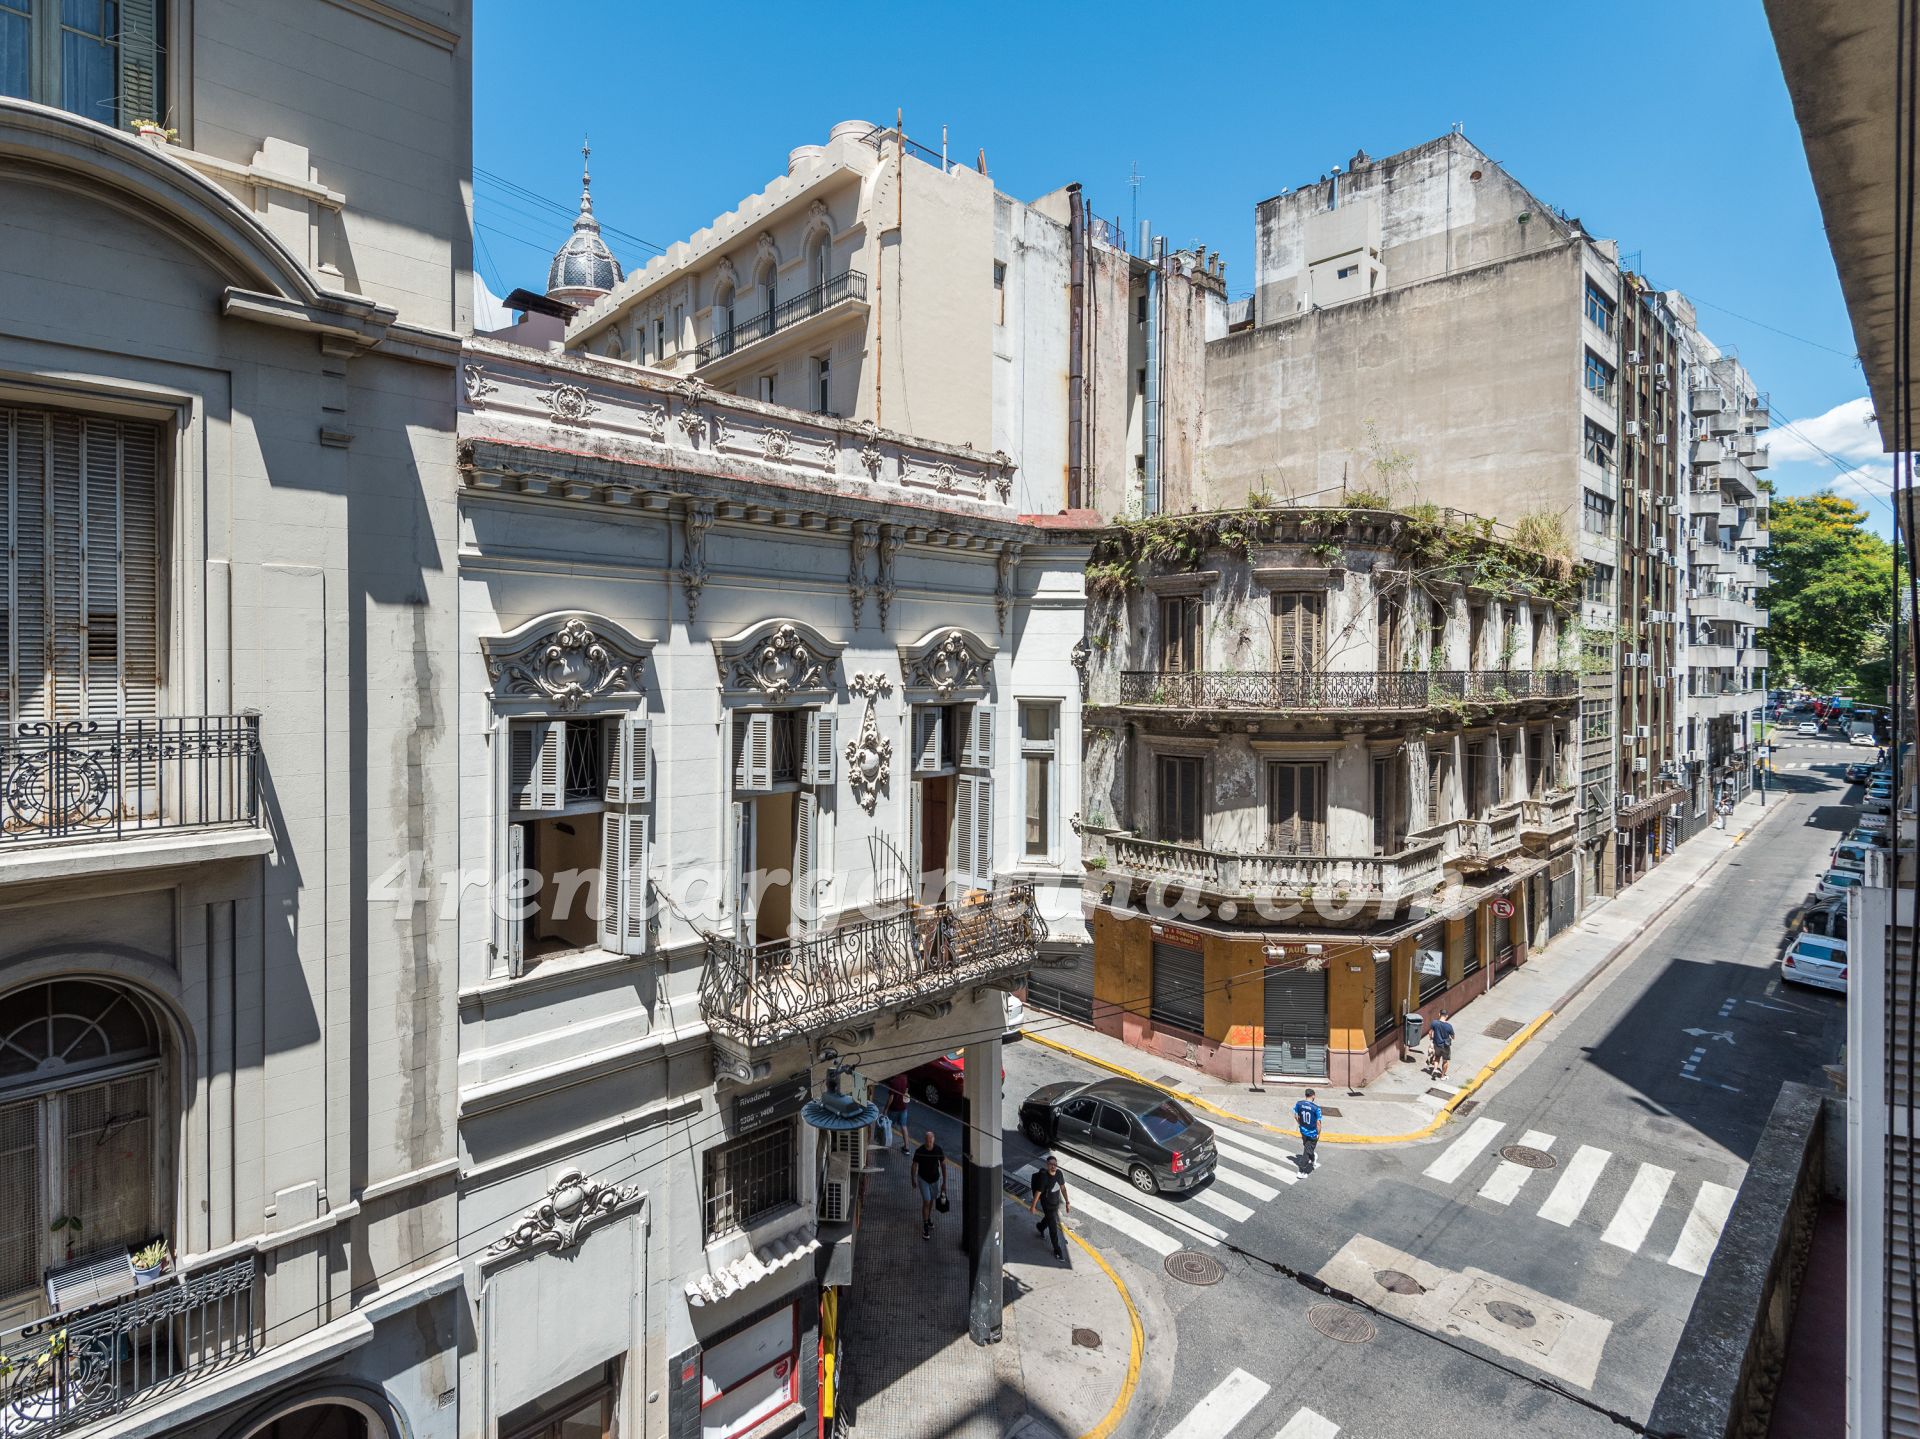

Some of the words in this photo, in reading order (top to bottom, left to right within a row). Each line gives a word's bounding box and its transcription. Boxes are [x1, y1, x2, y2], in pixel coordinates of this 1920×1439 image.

[740, 1089, 771, 1106] Rivadavia
[760, 1105, 774, 1118] 1400
[1301, 1110, 1311, 1124] 10
